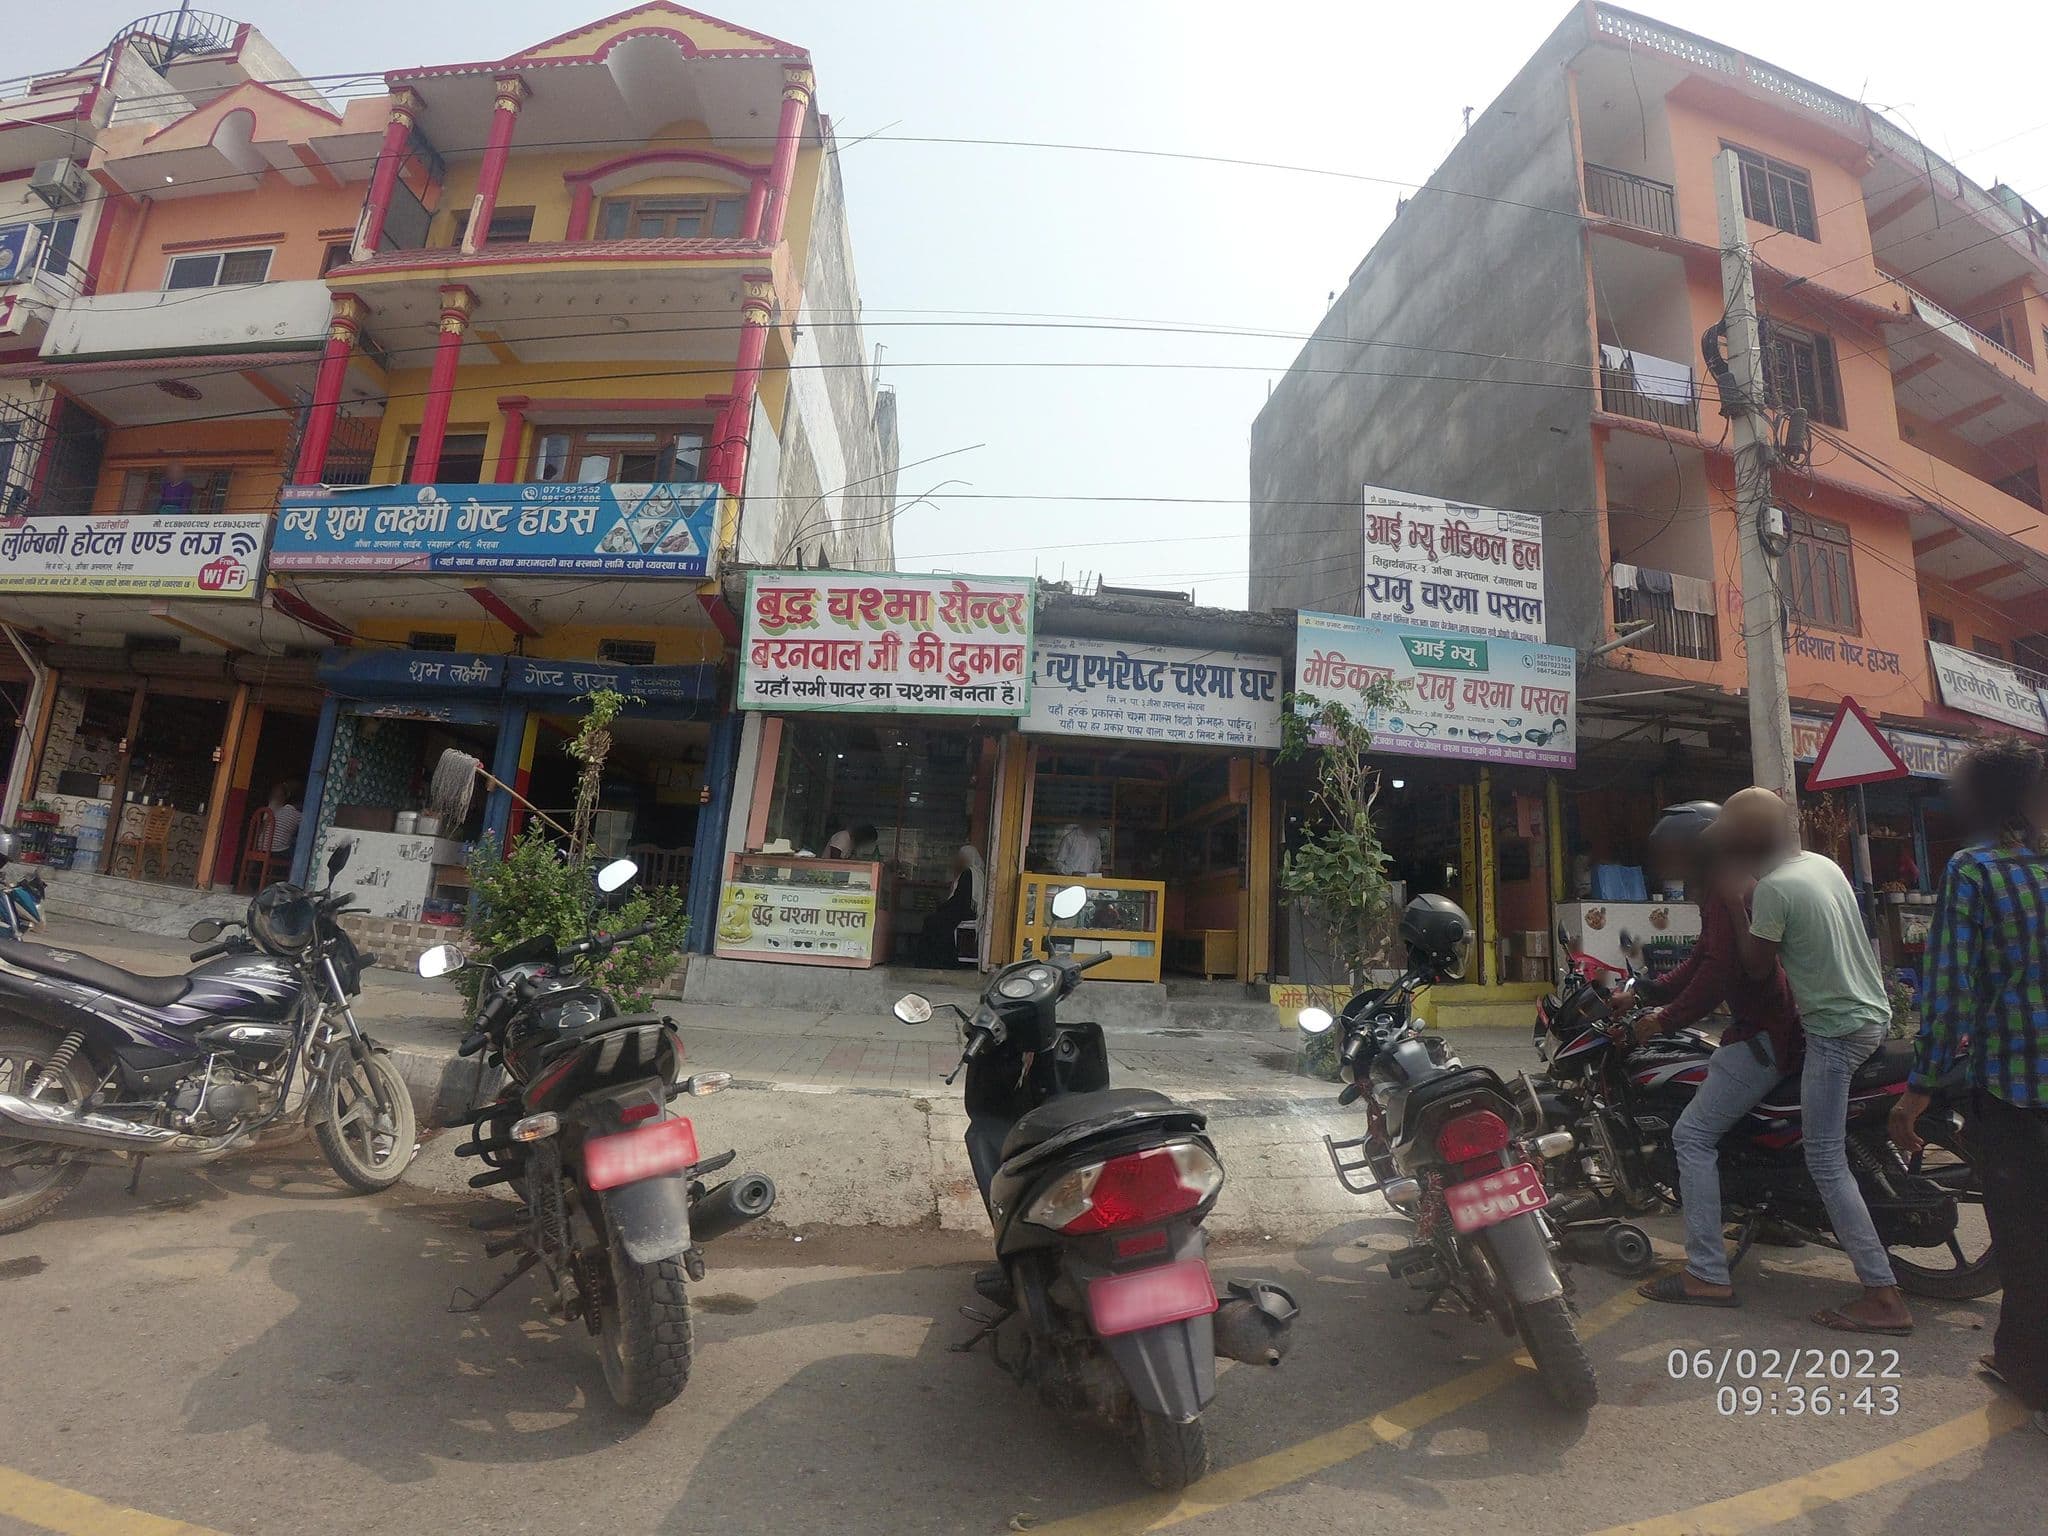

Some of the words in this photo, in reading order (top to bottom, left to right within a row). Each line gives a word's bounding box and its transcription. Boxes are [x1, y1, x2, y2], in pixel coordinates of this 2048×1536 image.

[284, 507, 321, 541] न्यू
[326, 506, 370, 541] शुभ
[375, 498, 451, 536] लक्ष्मी
[457, 498, 513, 533] गेष्ट
[518, 506, 599, 536] हाउस
[1367, 511, 1402, 551] आई
[1440, 519, 1507, 565] मेडिकल
[1512, 538, 1541, 571] हल
[2, 525, 69, 561] लुम्बिनी
[71, 524, 127, 556] होटल
[132, 532, 176, 555] एण्ड
[180, 532, 226, 556] लज
[219, 557, 236, 566] Free
[827, 588, 934, 630] चश्मा
[938, 580, 1027, 633] सेन्टर
[1367, 574, 1413, 614] रामु
[1420, 581, 1479, 615] चश्मा
[1486, 591, 1542, 625] पसल
[409, 660, 444, 682] शुभ
[450, 658, 493, 685] लक्ष्मी
[525, 663, 564, 687] गेष्ट
[572, 671, 619, 690] हाउस
[751, 638, 863, 672] बरनवाल
[868, 630, 902, 672] जी
[909, 631, 946, 673] की
[946, 642, 1025, 686] दुकान
[1411, 639, 1447, 660] आई
[1450, 644, 1478, 668] भ्यू
[754, 675, 791, 698] यहाँ
[792, 675, 827, 698] सभी
[829, 682, 866, 700] पावर
[869, 682, 892, 699] का
[896, 683, 947, 702] चश्मा
[950, 685, 997, 703] बनता
[1046, 652, 1087, 693] न्यू
[1170, 662, 1235, 699] चश्मा
[1238, 667, 1277, 702] घर
[1417, 672, 1457, 712] रामु
[1462, 678, 1514, 710] चश्मा
[1520, 684, 1570, 716] पसल
[780, 906, 821, 925] चश्मा
[826, 909, 868, 928] पसल
